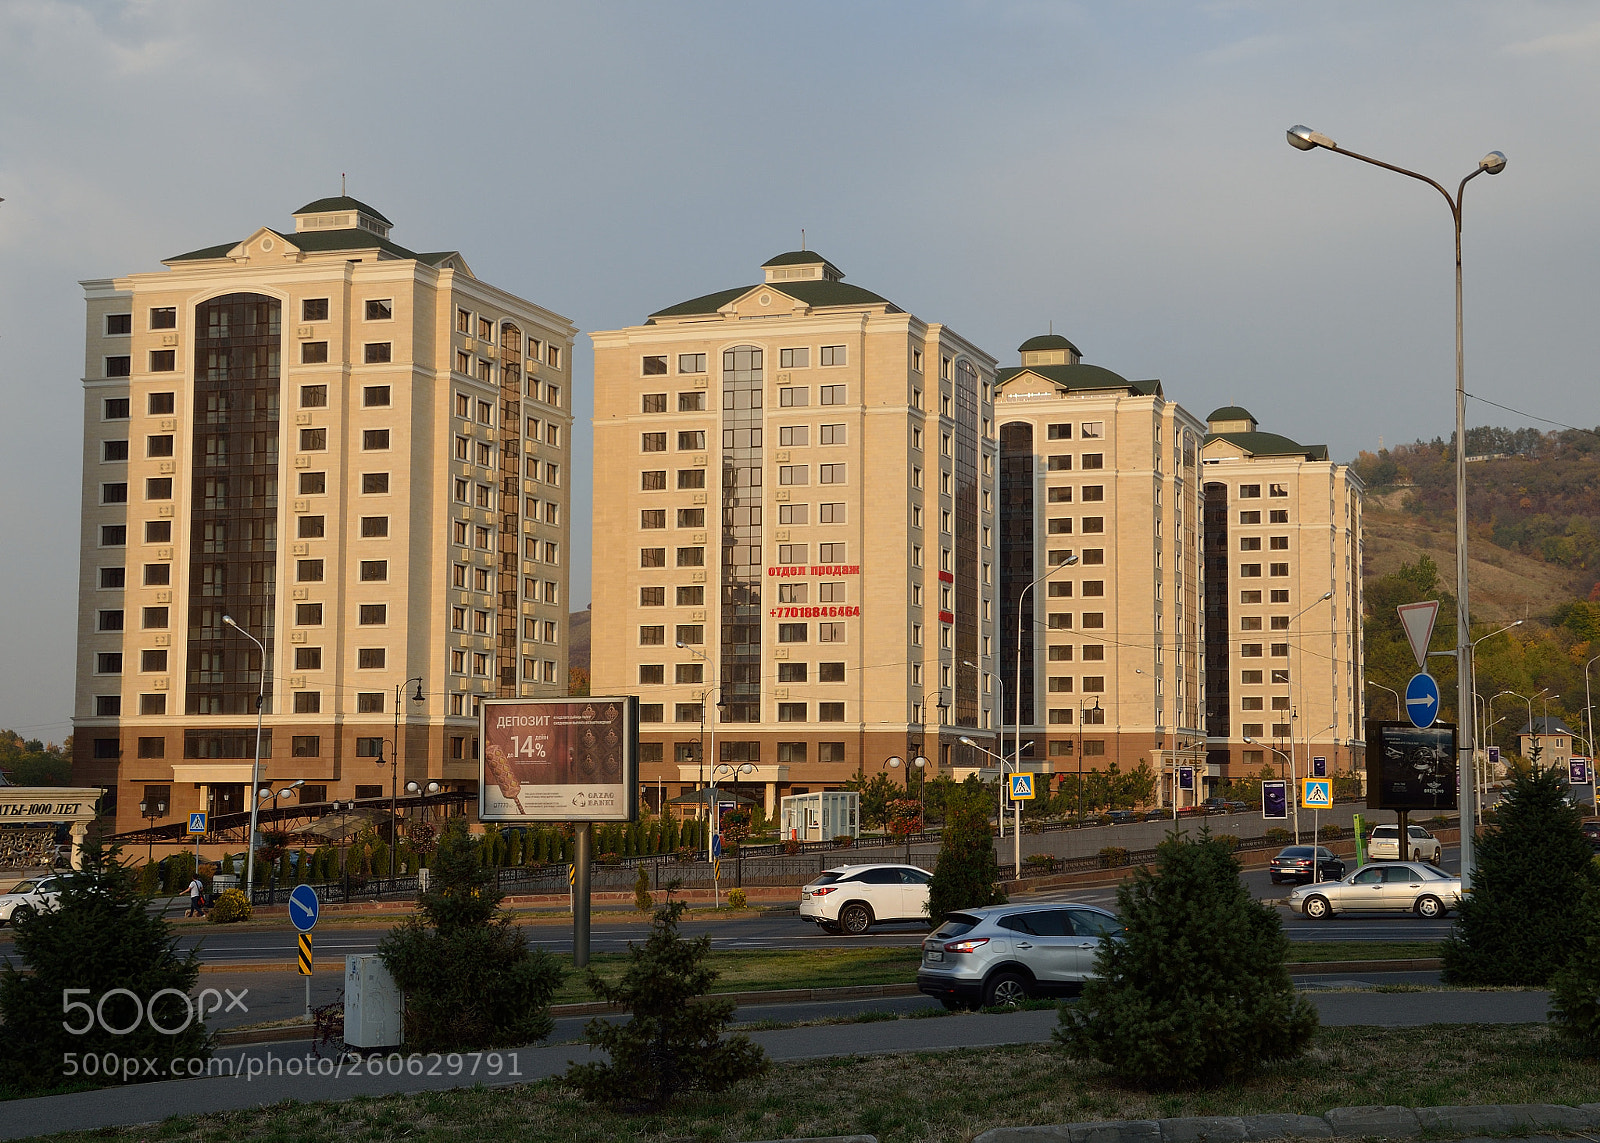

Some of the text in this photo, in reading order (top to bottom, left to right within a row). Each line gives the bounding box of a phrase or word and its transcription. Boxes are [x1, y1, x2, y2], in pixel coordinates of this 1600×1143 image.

[770, 606, 860, 618] +77018846464
[497, 715, 551, 729] ДЕПОЗИТ
[53, 803, 81, 814] ЛЕТ
